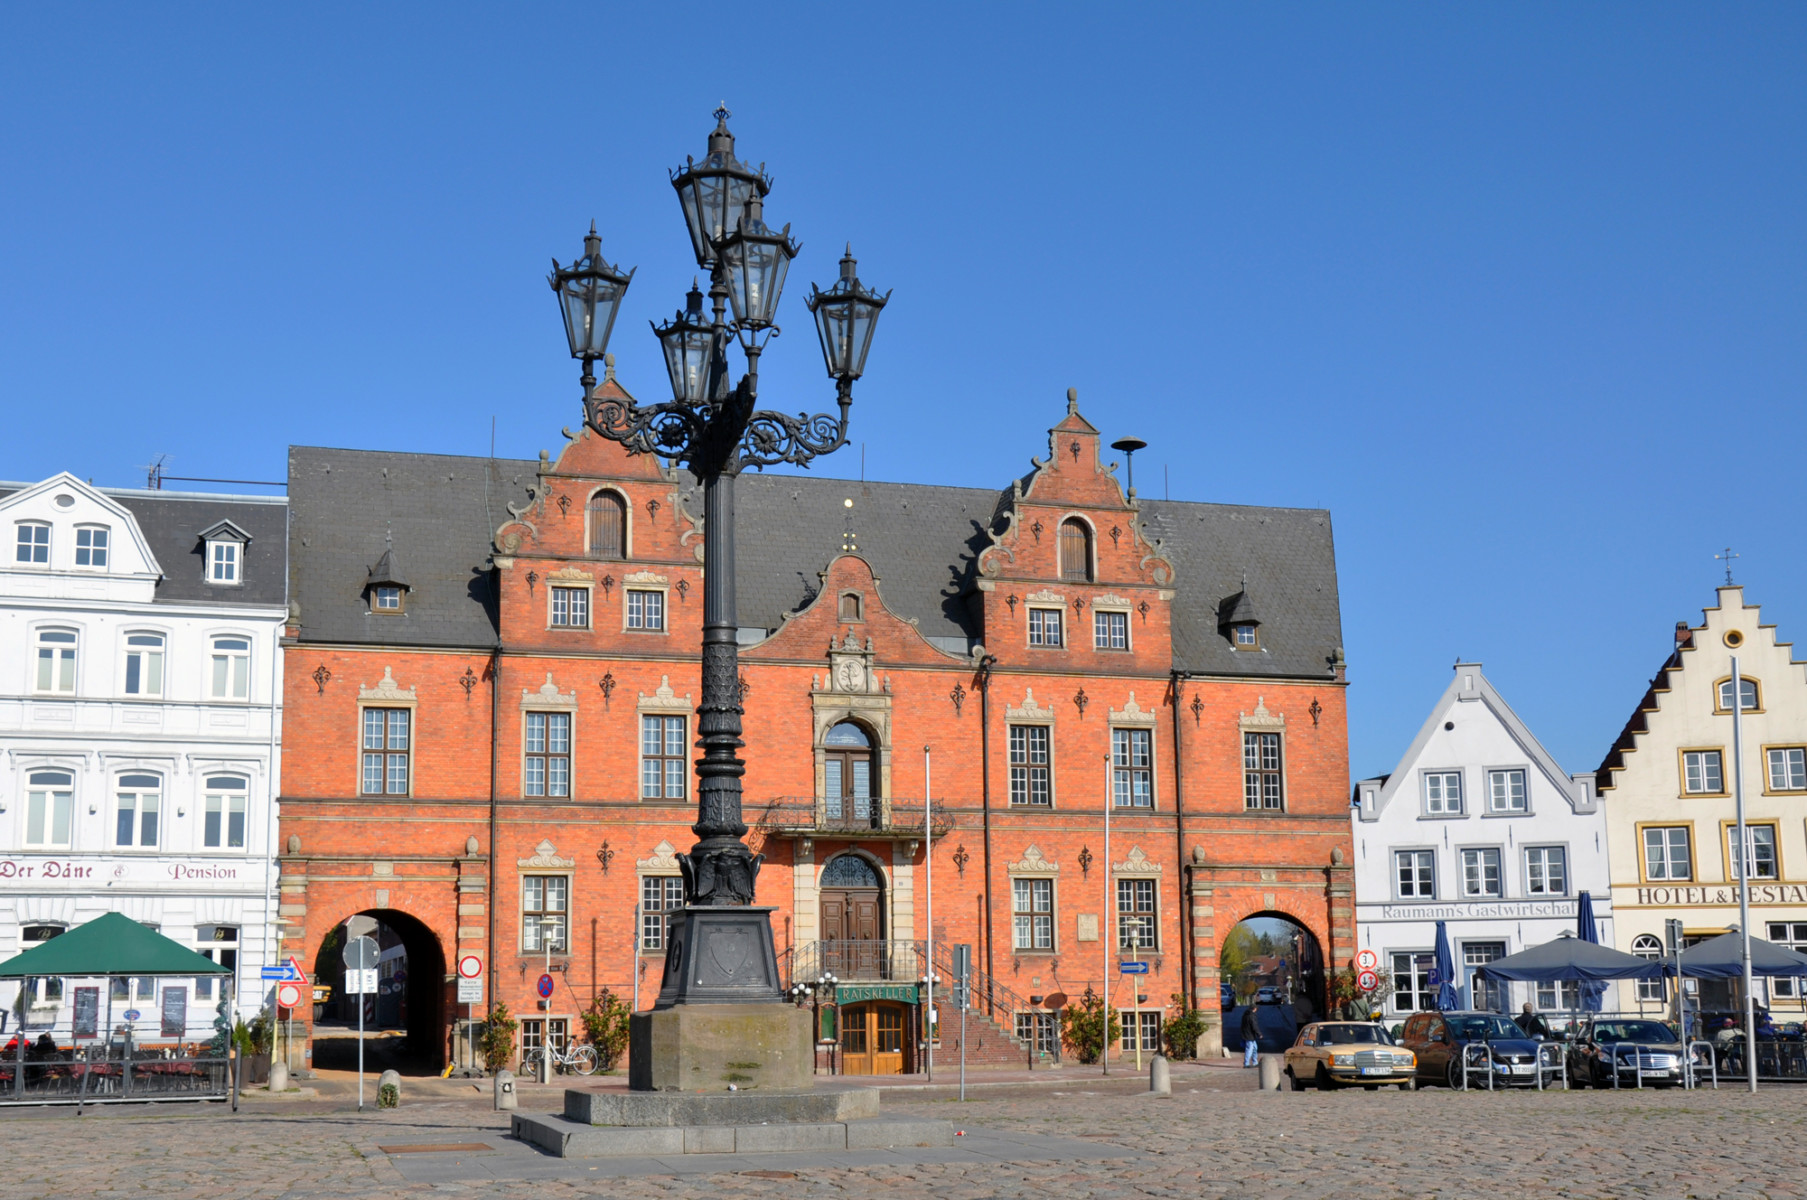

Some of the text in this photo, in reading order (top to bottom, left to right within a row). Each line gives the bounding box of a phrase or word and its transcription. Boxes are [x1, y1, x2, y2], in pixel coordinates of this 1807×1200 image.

[0, 861, 34, 878] Der
[168, 863, 237, 880] Pension
[1637, 887, 1715, 905] HOTEL
[1731, 886, 1807, 903] RESTA
[1382, 901, 1578, 919] Raumann's Gastwirtschaf
[843, 987, 912, 999] RATSKELLER
